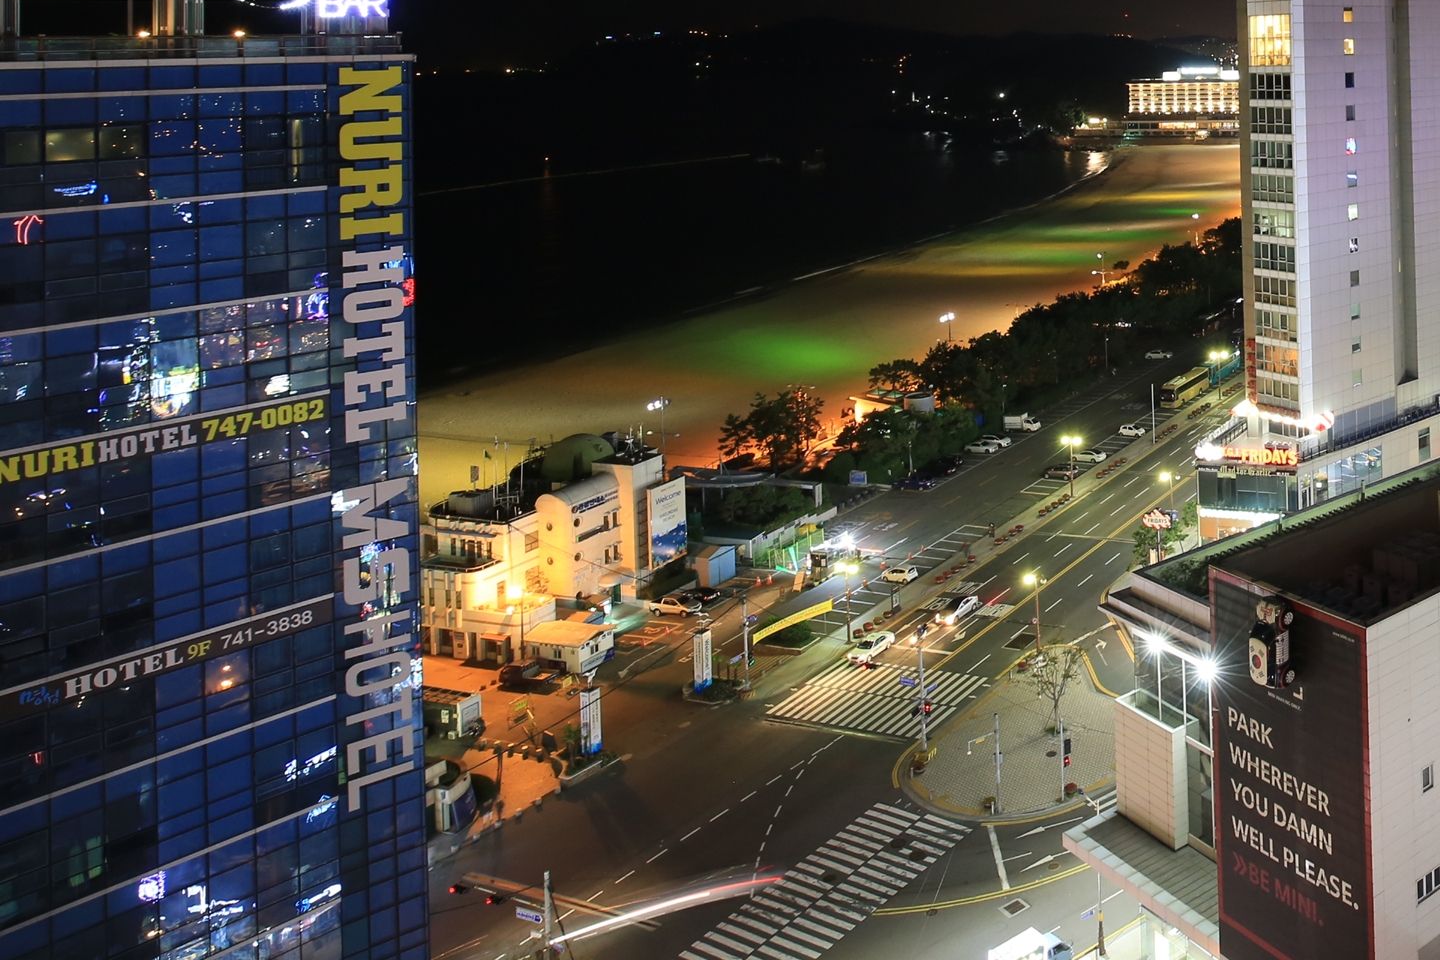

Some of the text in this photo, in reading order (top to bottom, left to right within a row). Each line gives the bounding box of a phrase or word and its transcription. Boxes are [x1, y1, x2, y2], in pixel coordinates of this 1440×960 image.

[338, 66, 408, 443] NURI HOTEL
[98, 424, 197, 463] HOTEL
[202, 399, 324, 441] 747-0082
[1240, 448, 1298, 466] FRIDAYS
[655, 490, 682, 505] Welcome
[65, 648, 184, 699] HOTEL
[187, 640, 212, 660] 9F
[220, 610, 313, 650] 741-3838
[1228, 706, 1274, 749] PARK
[1229, 742, 1331, 817] WHEREVER
[1230, 778, 1333, 855] YOU DAMN
[1231, 815, 1359, 911] WELL PLEASE.
[1274, 878, 1324, 928] MINI.
